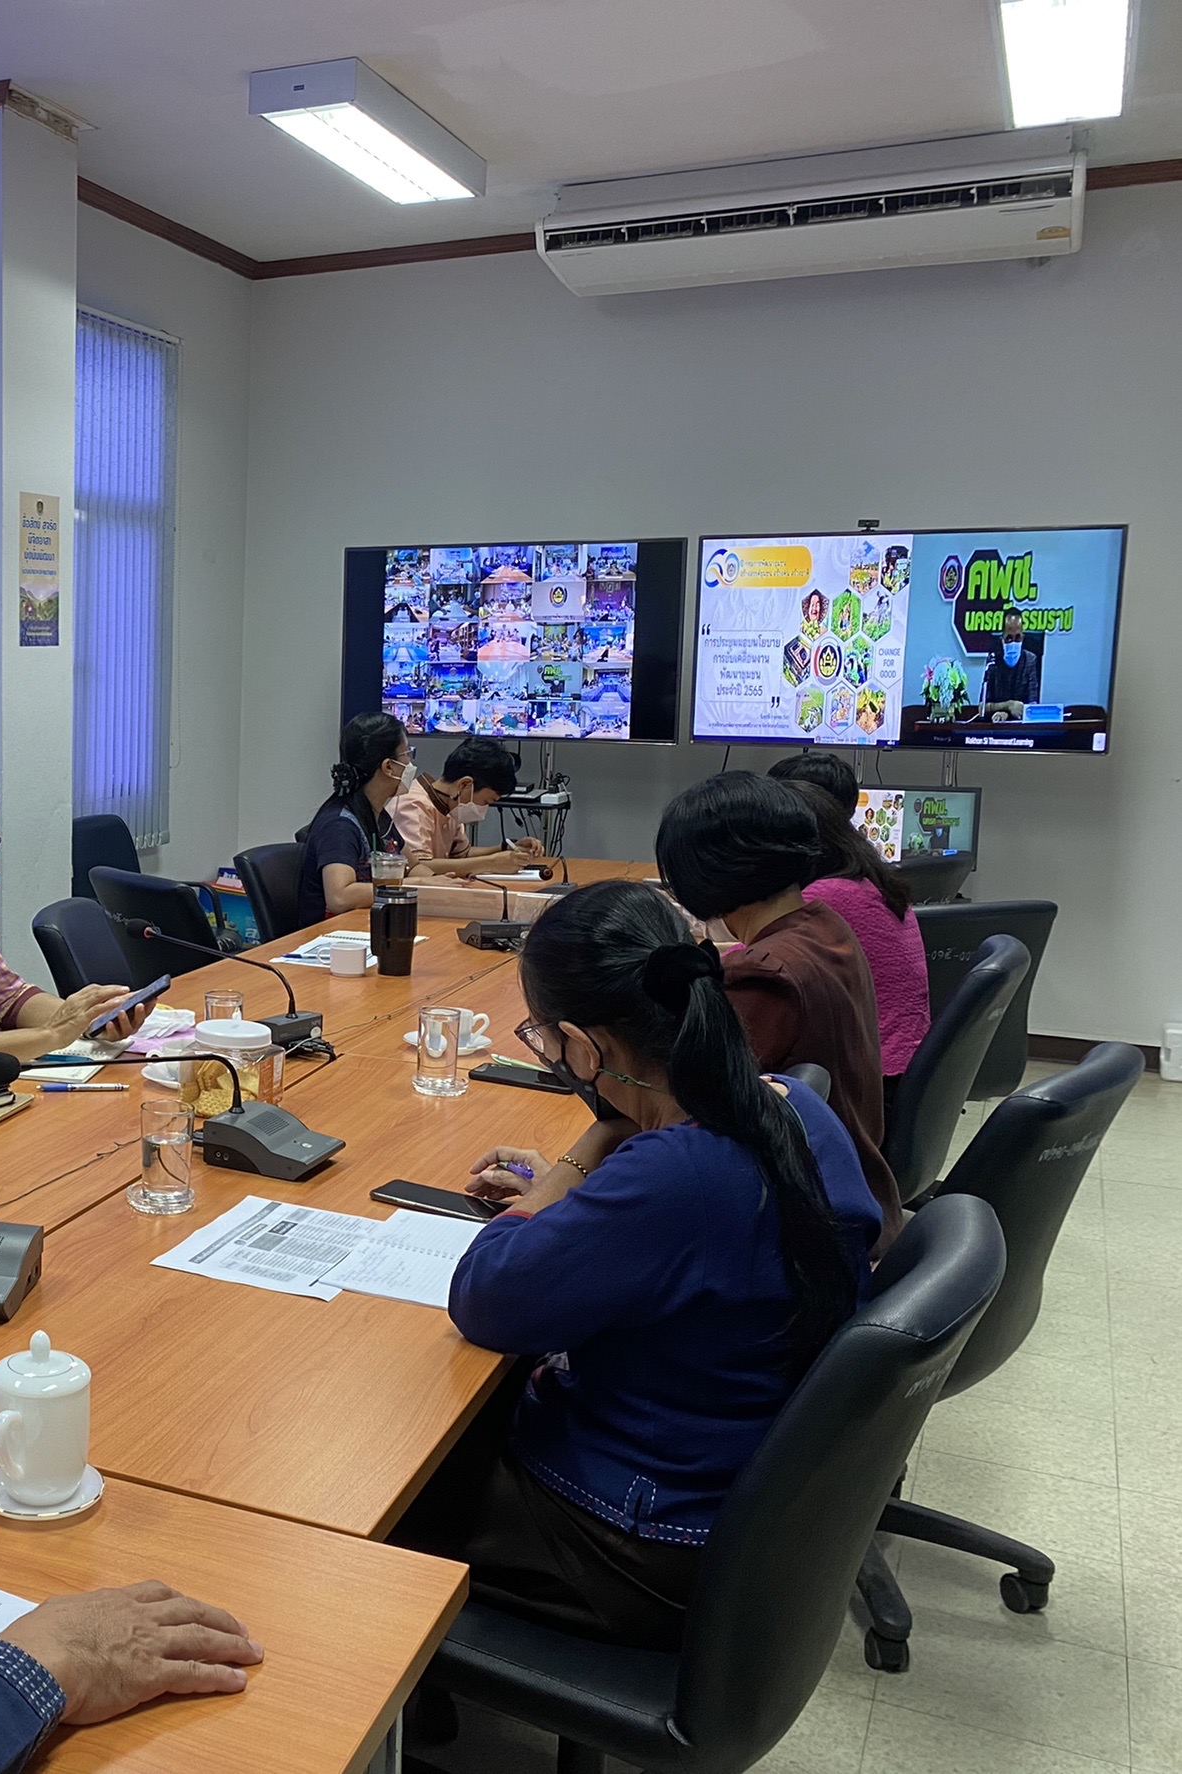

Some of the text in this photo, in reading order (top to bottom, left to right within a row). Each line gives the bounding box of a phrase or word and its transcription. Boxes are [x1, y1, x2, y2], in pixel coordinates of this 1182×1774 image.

[967, 553, 1037, 600] ศพช.
[878, 648, 901, 656] CHANGE
[883, 659, 895, 667] FOR
[720, 666, 761, 684] พัฒนาชุมชน
[880, 670, 897, 679] GOOD
[716, 683, 764, 697] ประจำปี 2565
